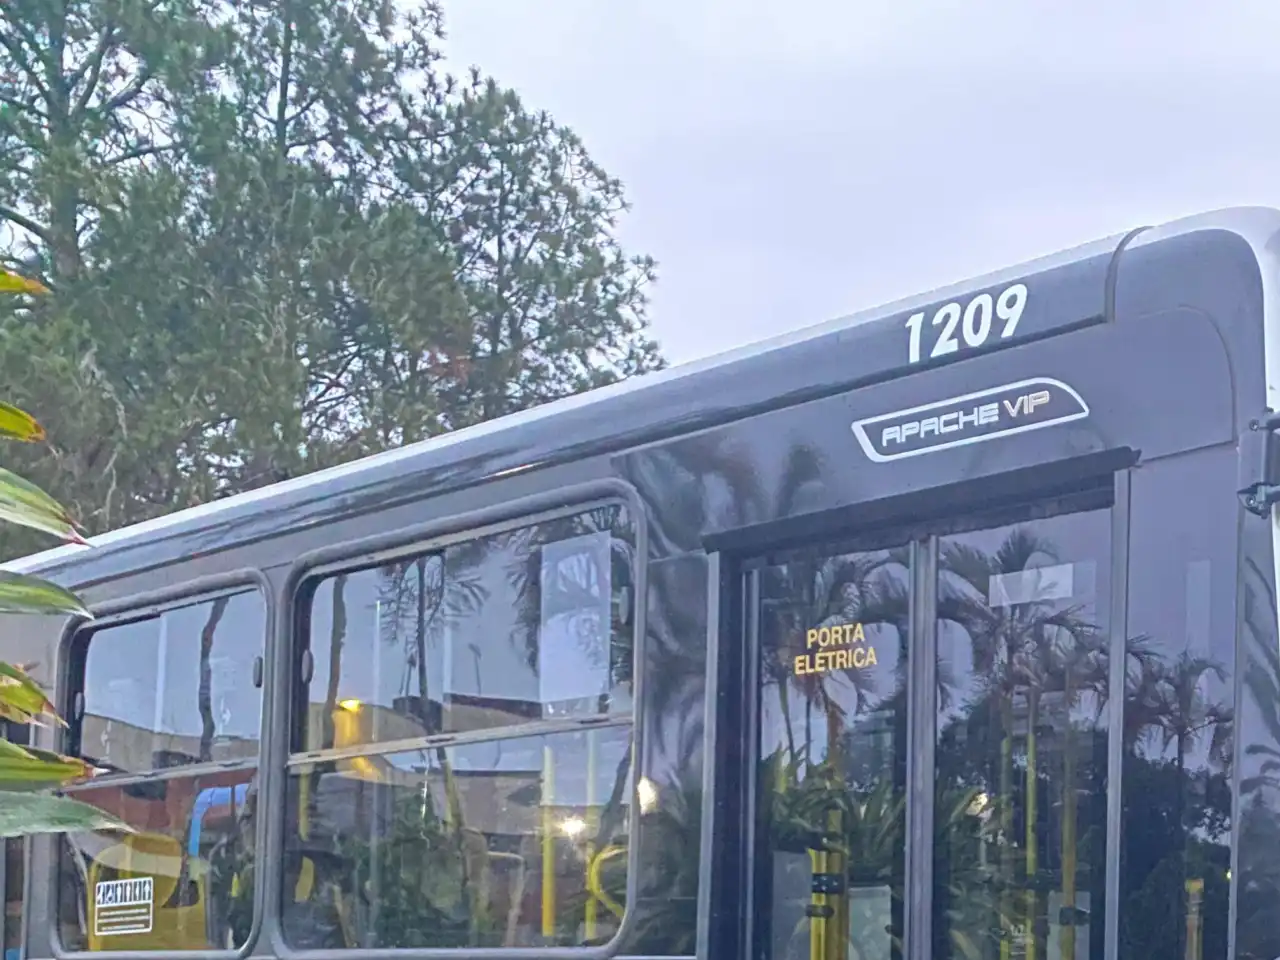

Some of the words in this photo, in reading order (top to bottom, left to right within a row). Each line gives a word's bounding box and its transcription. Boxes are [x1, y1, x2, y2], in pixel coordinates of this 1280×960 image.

[905, 284, 1027, 363] 1209
[882, 402, 999, 447] APACHE
[1003, 391, 1050, 418] VIP
[806, 622, 866, 649] PORTA
[795, 646, 877, 675] ELÉTRICA
